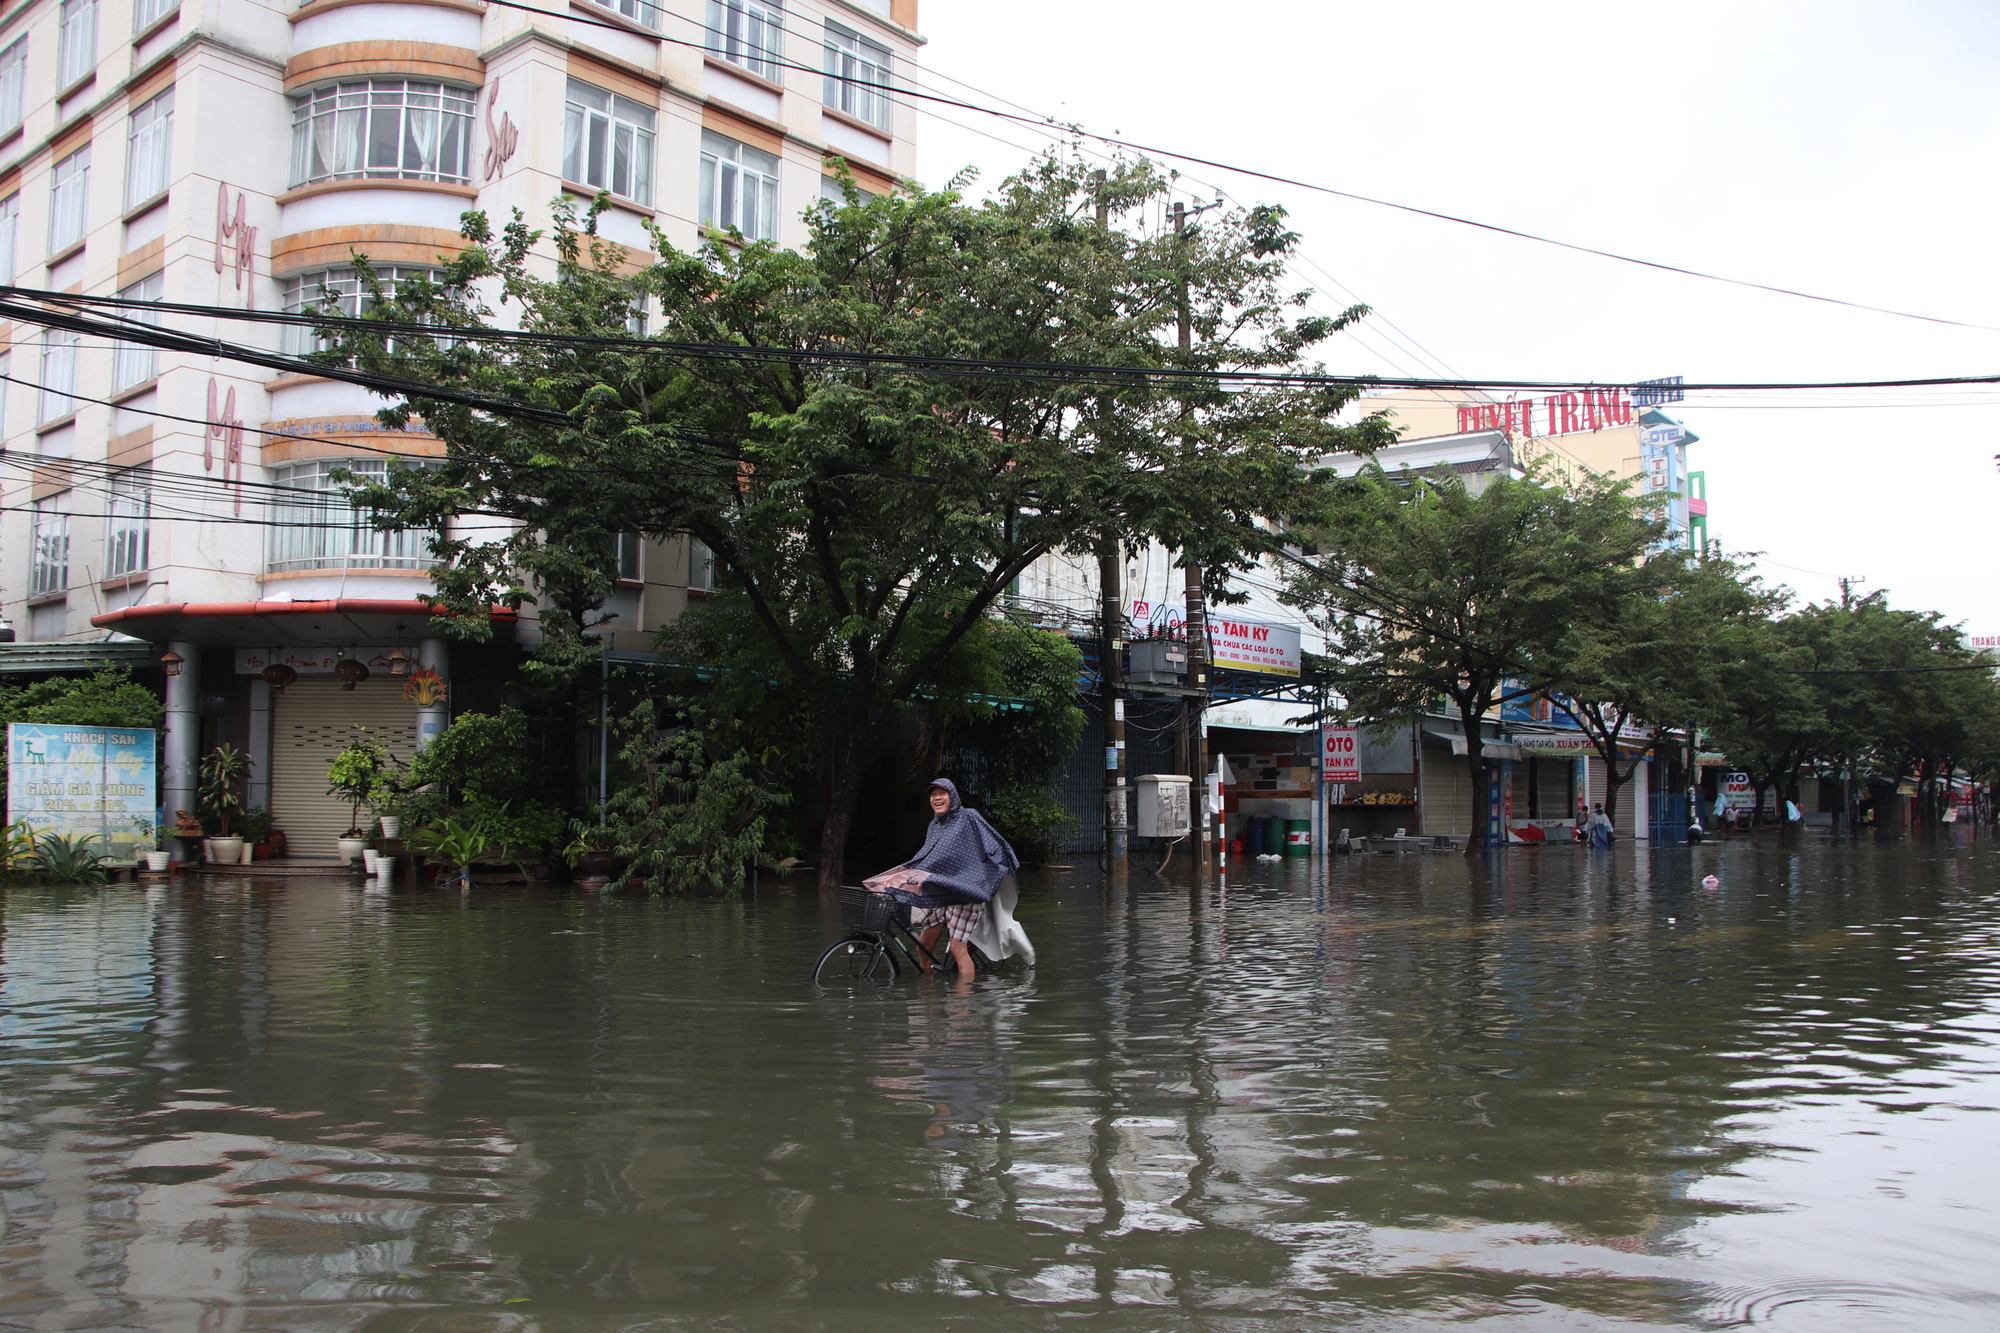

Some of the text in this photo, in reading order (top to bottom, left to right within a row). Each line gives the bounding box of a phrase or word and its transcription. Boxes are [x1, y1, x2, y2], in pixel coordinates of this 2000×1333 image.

[64, 730, 136, 747] KHÁCH SẠN
[45, 799, 127, 812] 20% 30%
